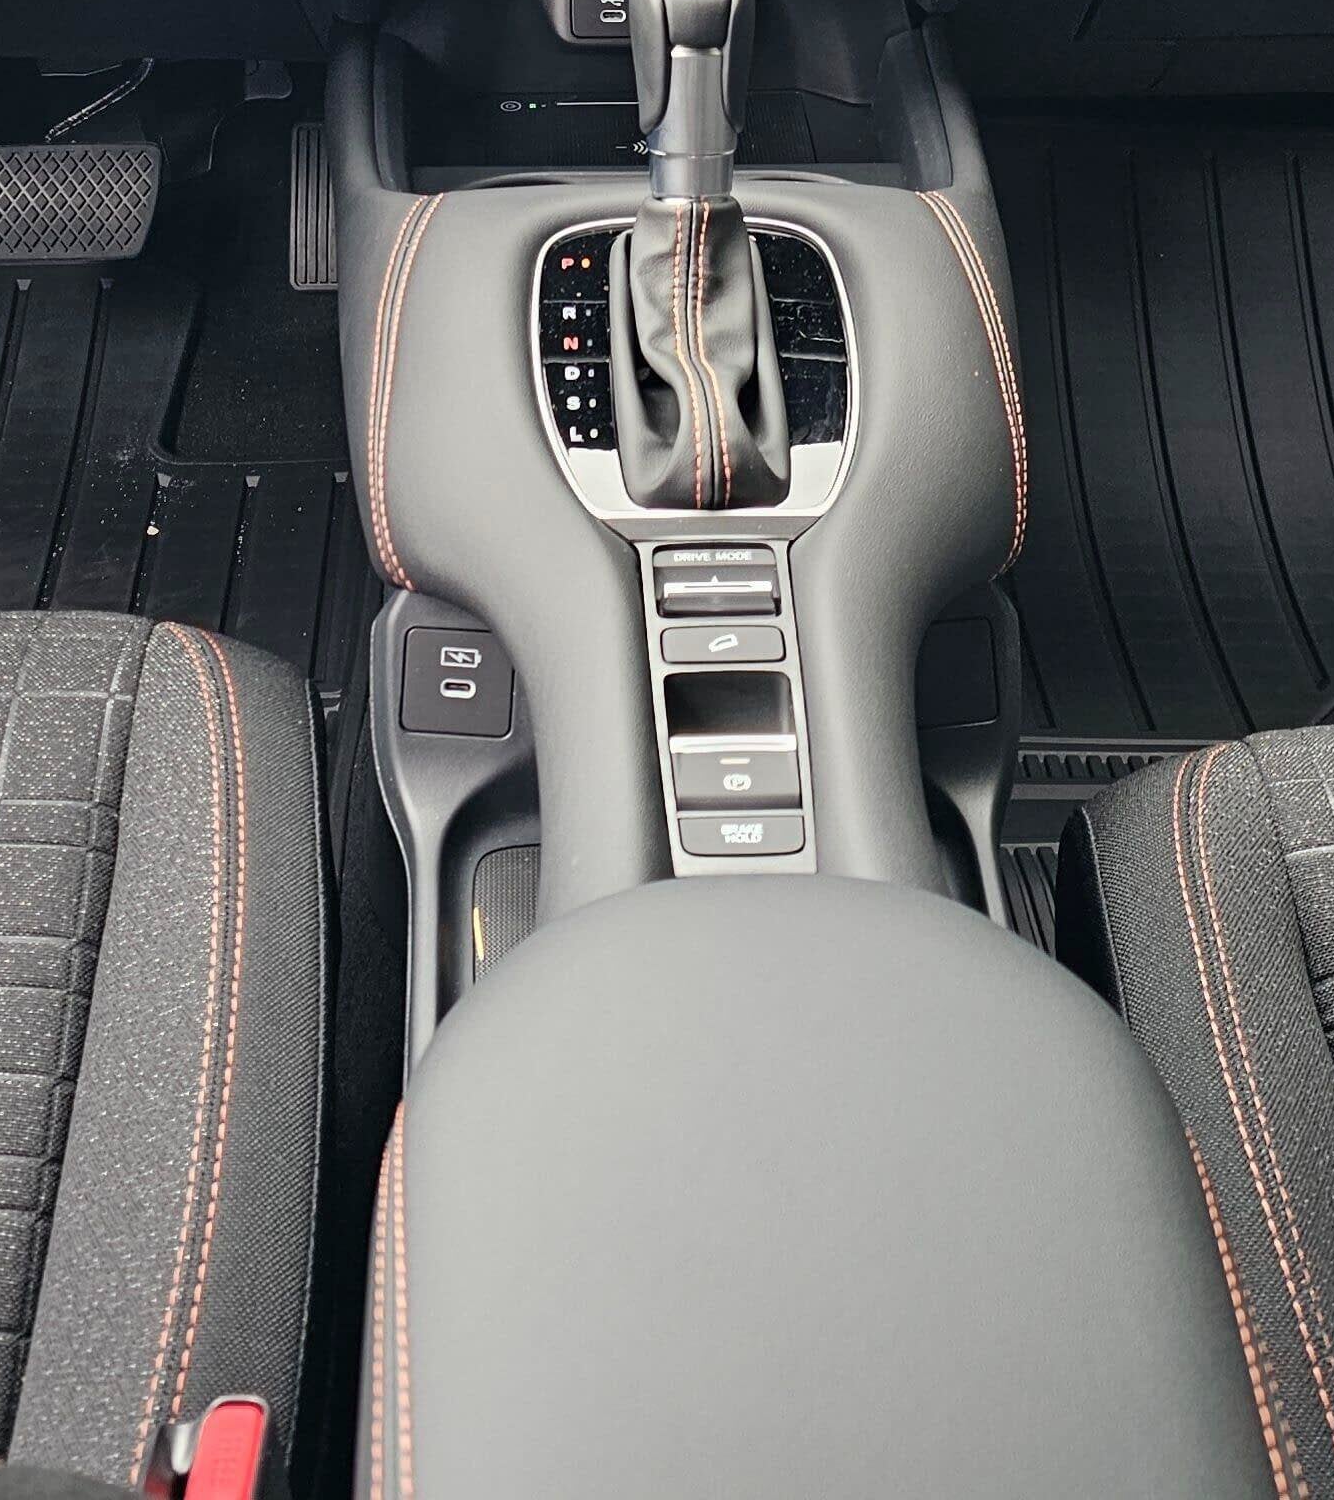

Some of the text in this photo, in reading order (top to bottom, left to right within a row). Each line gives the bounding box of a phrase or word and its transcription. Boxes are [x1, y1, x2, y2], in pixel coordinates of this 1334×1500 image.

[561, 257, 575, 270] P
[562, 306, 577, 320] R
[563, 337, 579, 350] N
[564, 366, 581, 381] D
[566, 396, 581, 411] S
[569, 426, 585, 442] L
[673, 550, 753, 562] DRIVE MODE
